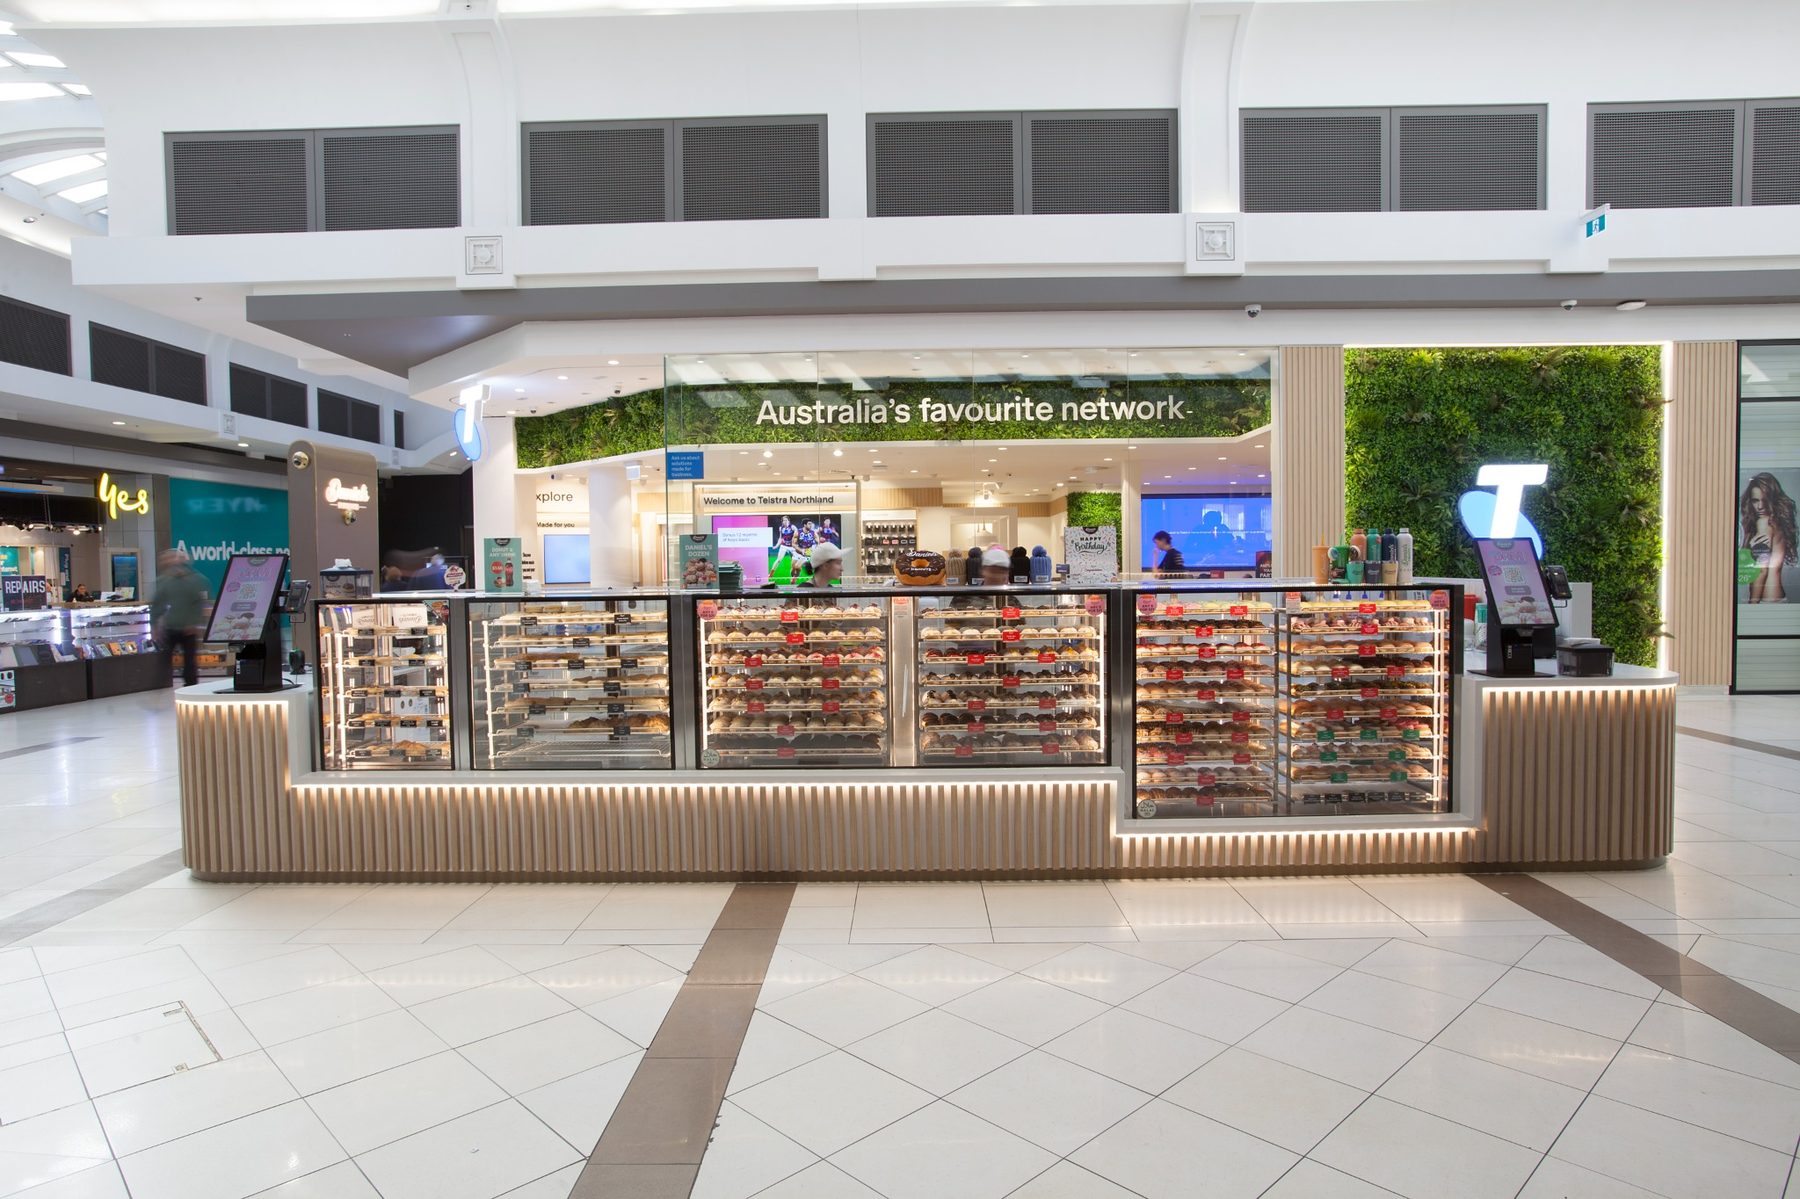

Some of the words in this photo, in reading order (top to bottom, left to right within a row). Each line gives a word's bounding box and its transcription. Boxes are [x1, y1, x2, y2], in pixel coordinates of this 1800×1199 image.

[755, 398, 912, 425] Australia’s
[918, 397, 1055, 424] favourite
[1061, 394, 1186, 421] network
[703, 497, 744, 506] Welcome
[747, 497, 756, 505] to
[757, 495, 788, 505] Telstra
[790, 494, 834, 504] Northland
[1074, 541, 1107, 554] Birthday
[5, 580, 46, 594] REPAIRS
